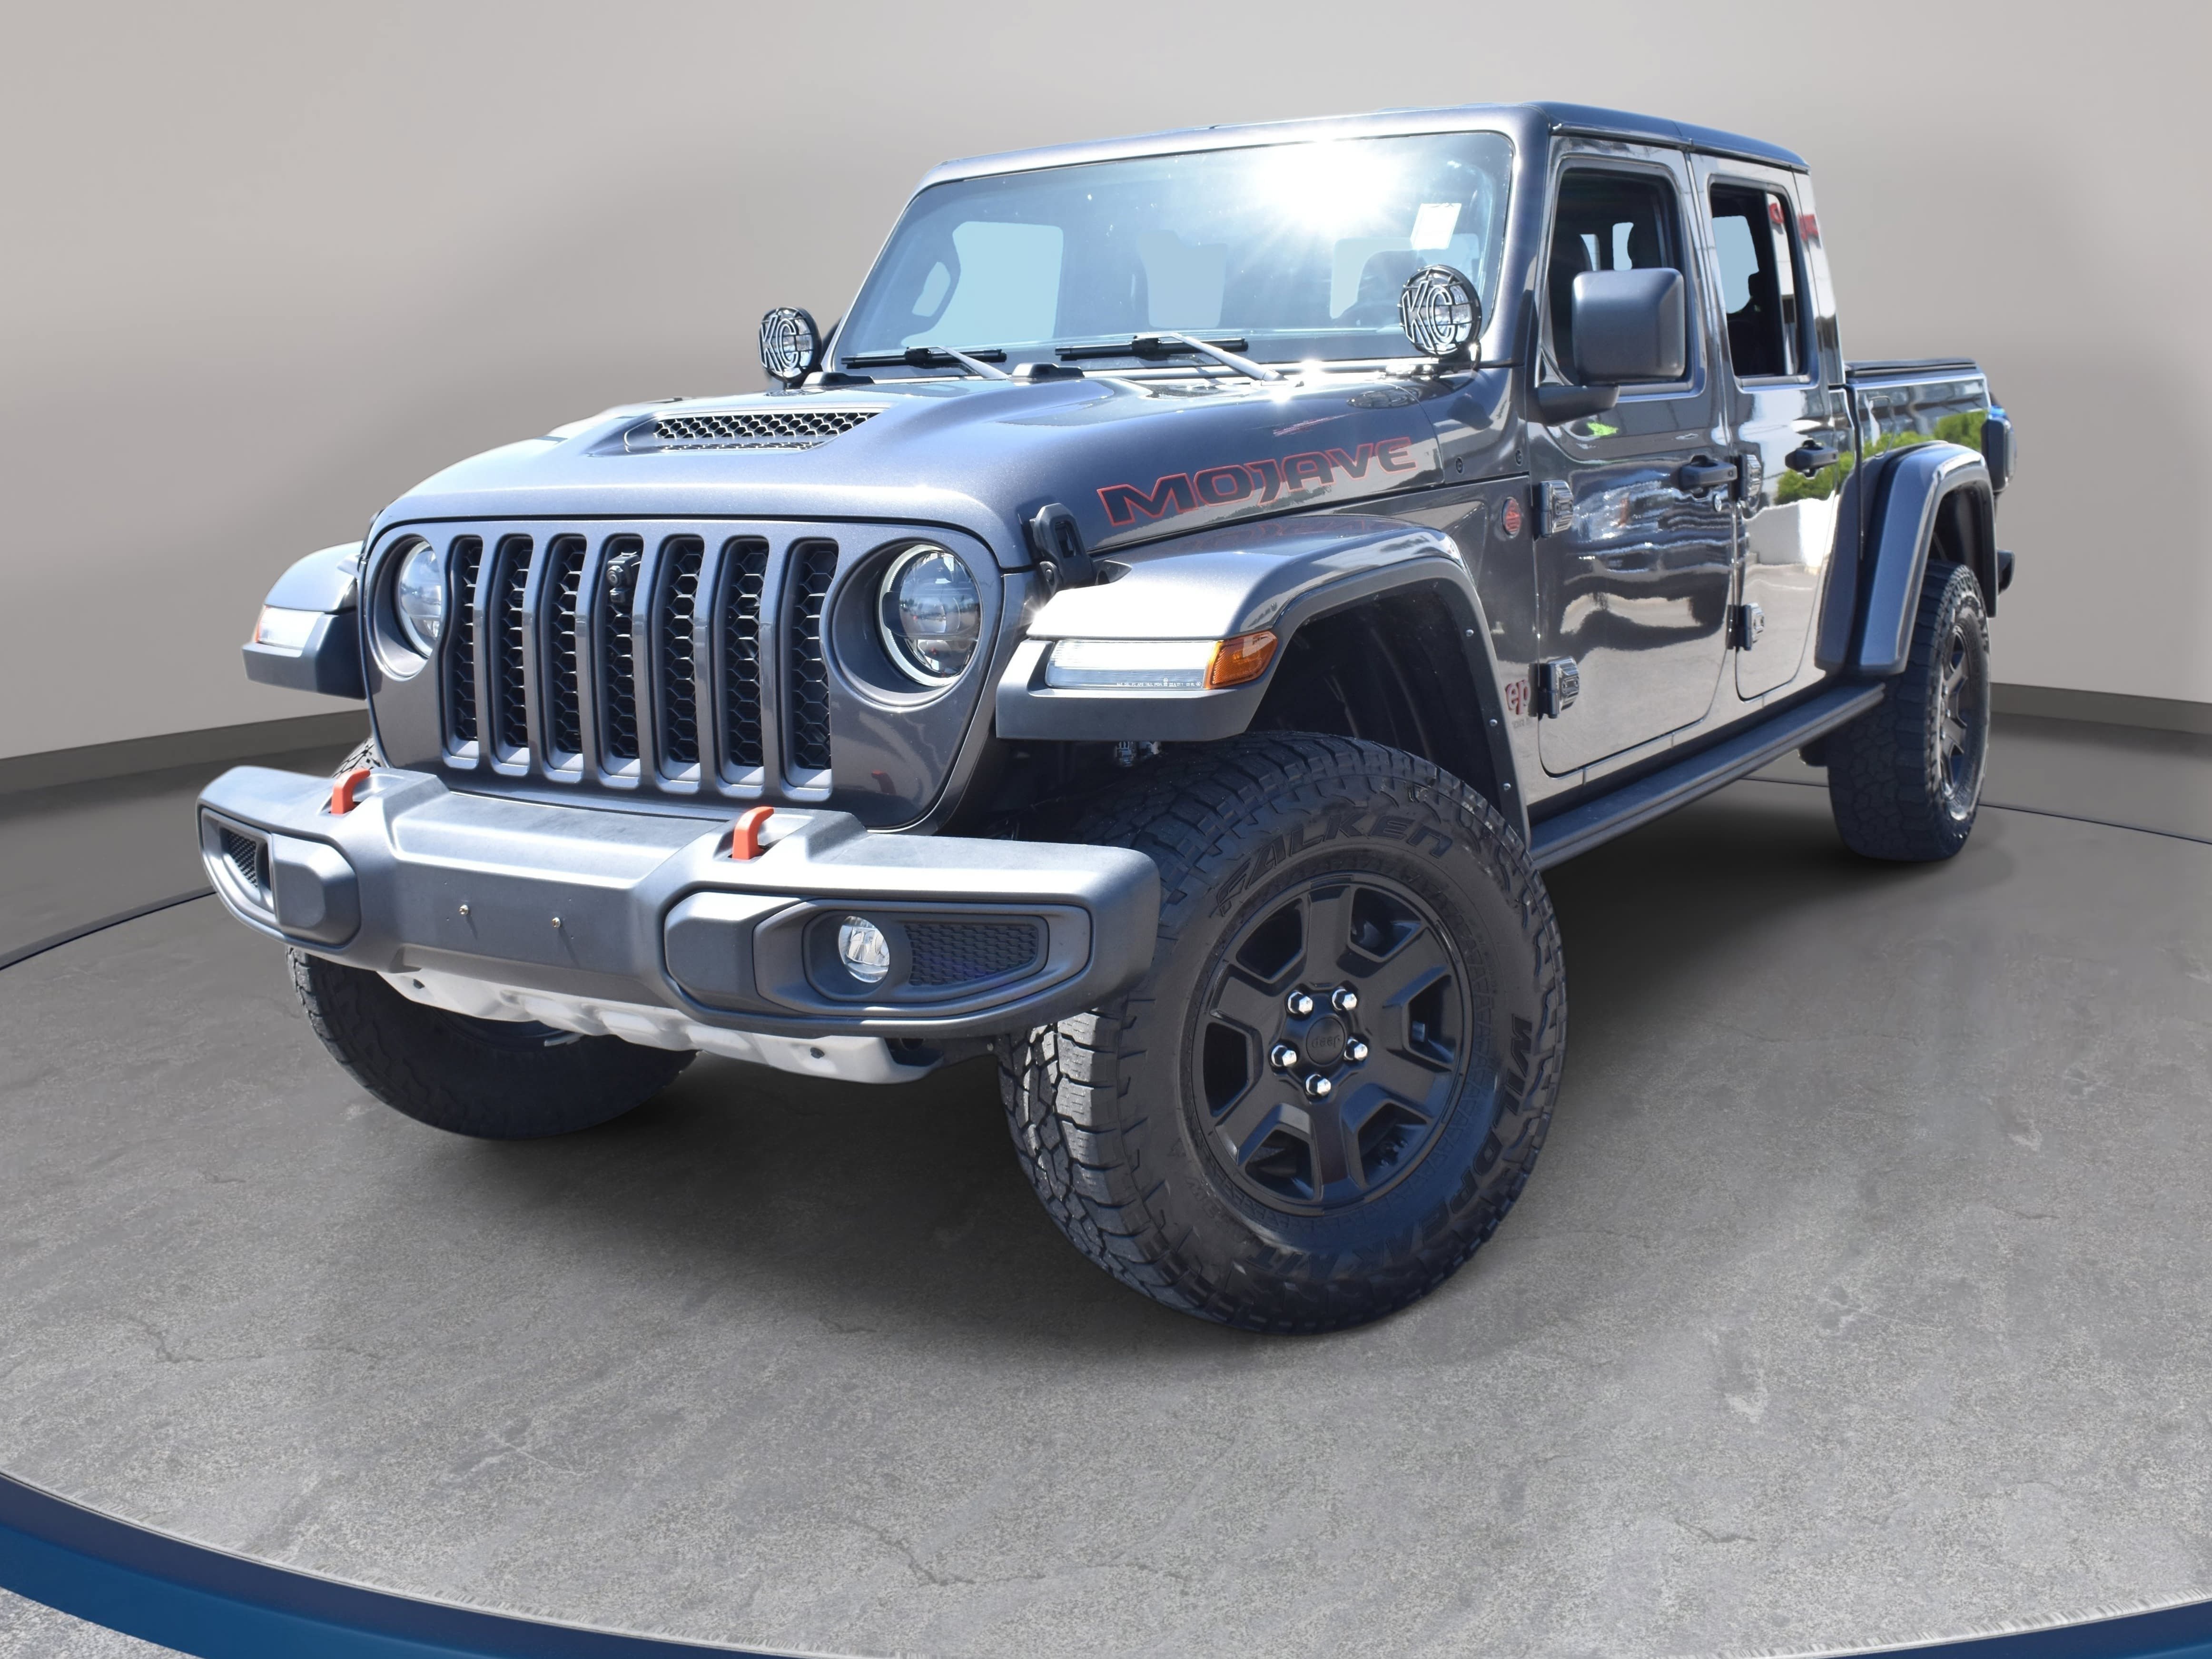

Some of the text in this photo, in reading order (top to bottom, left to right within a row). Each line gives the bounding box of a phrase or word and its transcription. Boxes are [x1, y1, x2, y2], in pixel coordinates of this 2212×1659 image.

[758, 315, 799, 373] KC
[1402, 280, 1456, 351] KC
[1096, 436, 1418, 526] MOJAVE
[1211, 813, 1453, 918] FALKEN
[1311, 1035, 1341, 1048] Jeep
[1350, 1013, 1532, 1274] WILDPEAK
